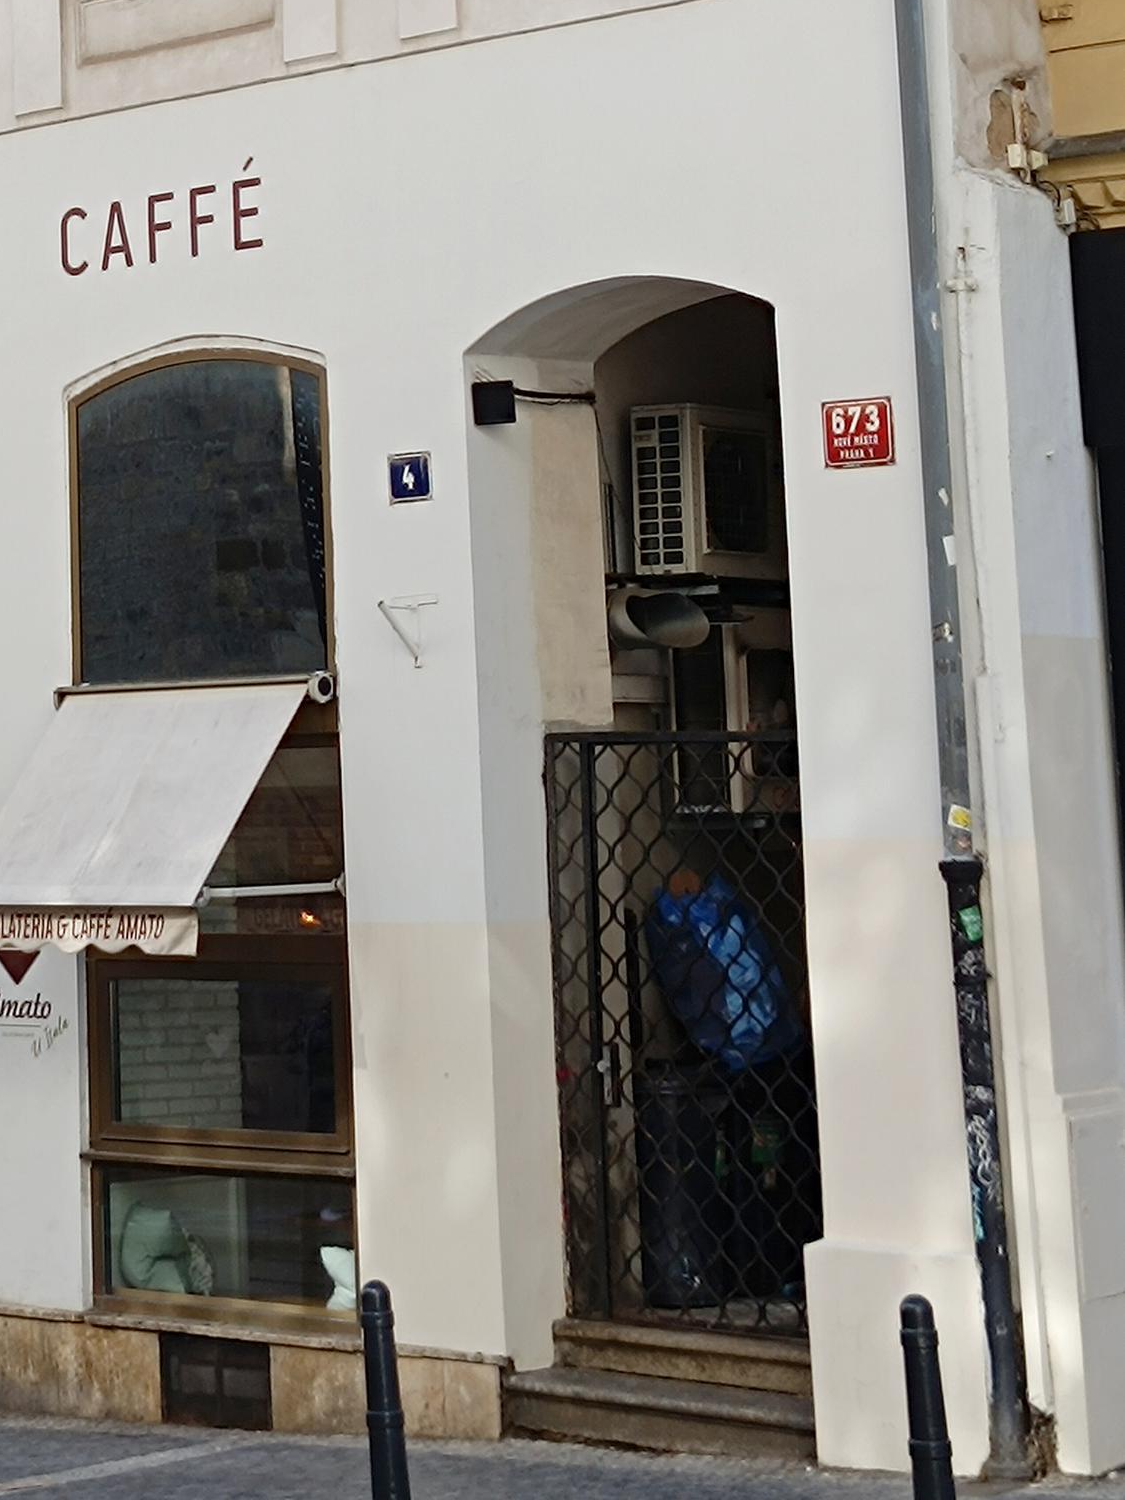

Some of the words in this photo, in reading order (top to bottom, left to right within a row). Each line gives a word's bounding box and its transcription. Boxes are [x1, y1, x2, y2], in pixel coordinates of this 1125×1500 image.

[60, 156, 263, 276] CAFFÉ
[831, 404, 880, 435] 673
[402, 462, 416, 490] 4
[71, 908, 112, 939] CAFFÉ
[116, 913, 165, 939] AMATO
